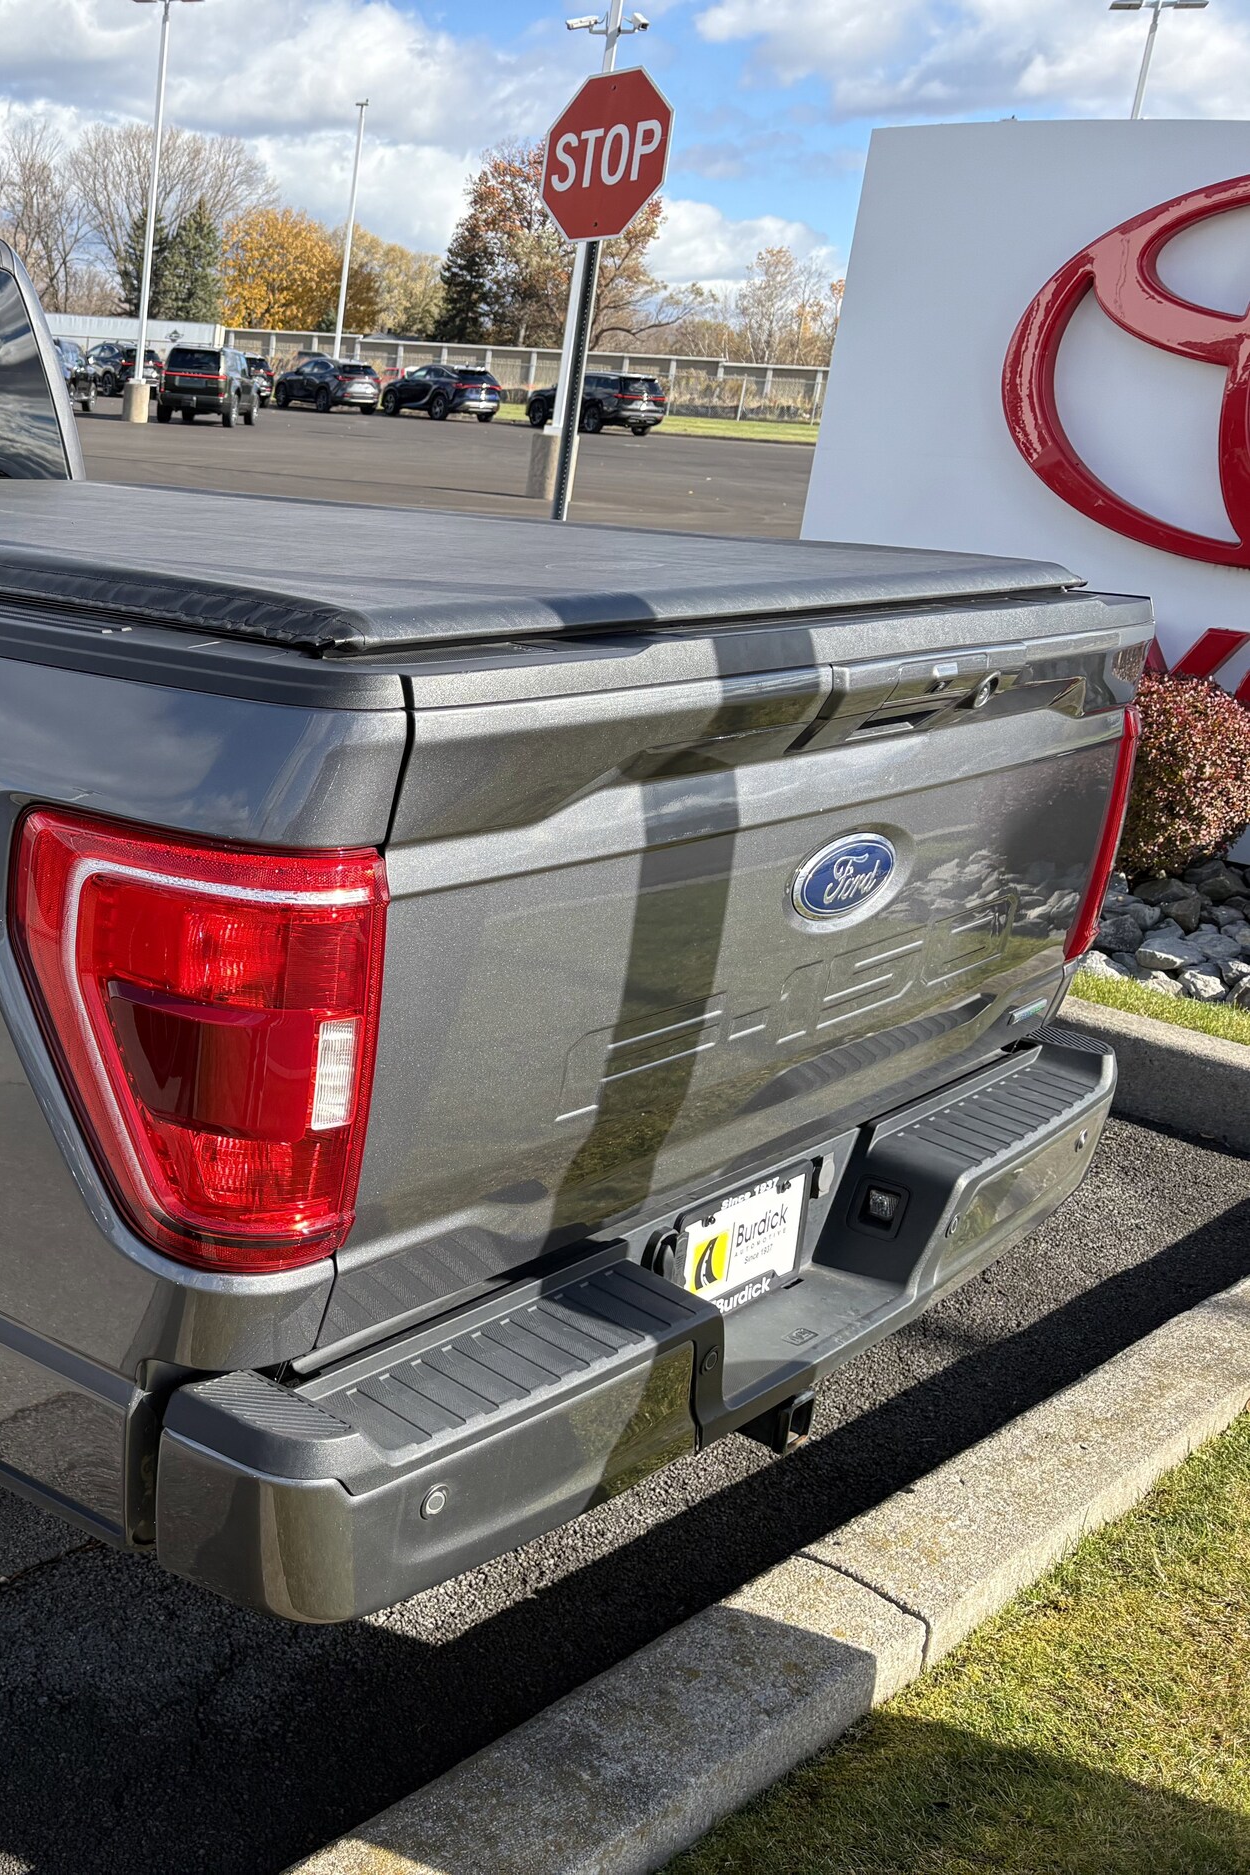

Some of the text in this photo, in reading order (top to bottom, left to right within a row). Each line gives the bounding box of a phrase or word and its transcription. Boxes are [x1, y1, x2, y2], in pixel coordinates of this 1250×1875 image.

[551, 119, 662, 192] STOP
[823, 852, 881, 905] Ford
[721, 1176, 780, 1211] Since 1937
[734, 1227, 786, 1257] AUTOMOTIVE
[736, 1203, 788, 1248] Burdick
[744, 1252, 759, 1265] Since
[716, 1276, 771, 1314] Burdick
